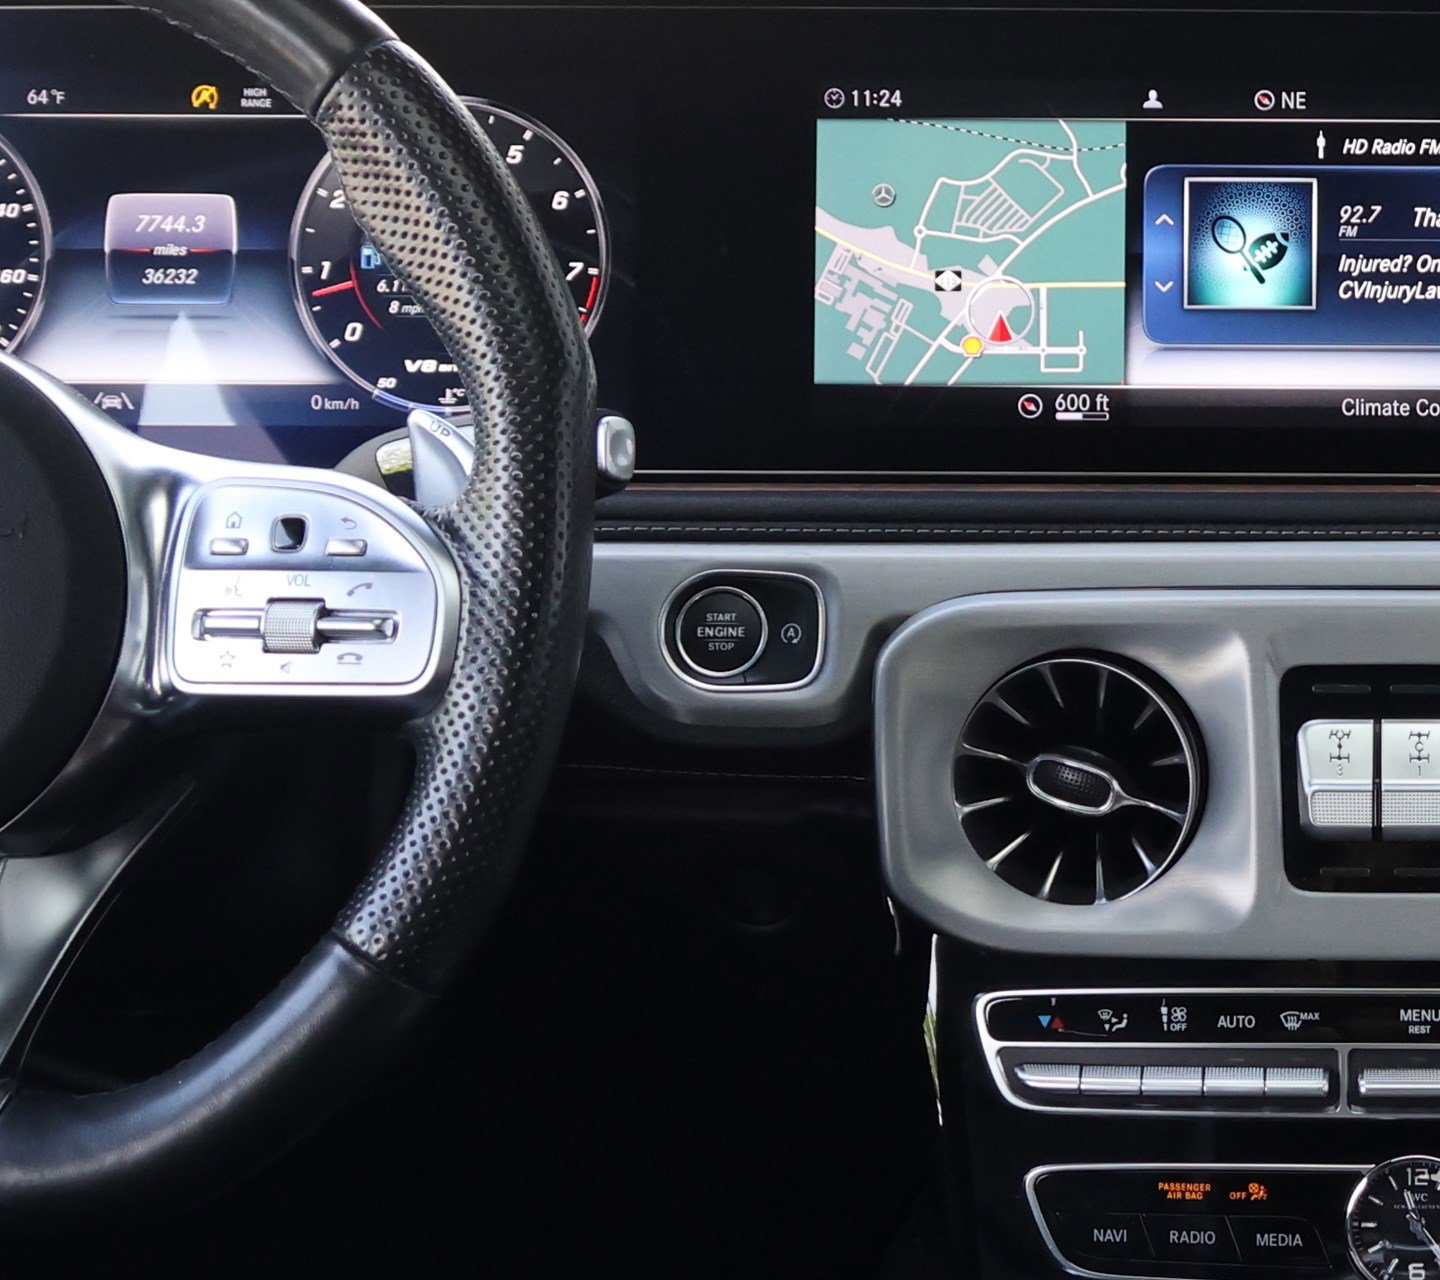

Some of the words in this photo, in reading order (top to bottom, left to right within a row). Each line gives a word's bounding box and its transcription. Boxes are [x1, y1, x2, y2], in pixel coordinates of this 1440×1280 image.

[26, 90, 48, 105] 64
[243, 88, 267, 97] HIGH
[851, 89, 903, 107] 11:24
[240, 98, 272, 108] RANGE
[1281, 92, 1307, 110] NE
[506, 145, 524, 164] 5
[1343, 138, 1369, 155] HD
[1371, 138, 1416, 156] Radio
[329, 190, 346, 209] 2
[552, 191, 570, 210] 6
[1340, 205, 1382, 223] 92.7
[134, 215, 207, 234] 7744.3
[1338, 226, 1358, 237] FM
[153, 244, 188, 256] miles
[320, 261, 331, 280] 1
[565, 262, 584, 281] 7
[1338, 254, 1413, 276] Injured?
[141, 269, 199, 284] 36232
[389, 300, 400, 314] 8
[344, 322, 363, 342] 0
[404, 359, 438, 373] V8
[376, 377, 397, 389] 50
[310, 395, 322, 410] 0
[324, 396, 360, 410] km/h
[1055, 393, 1091, 411] 600
[1095, 393, 1109, 411] ft
[1341, 398, 1410, 417] Climate
[429, 420, 452, 437] UP
[286, 574, 312, 587] VOL
[706, 612, 737, 622] START
[697, 626, 746, 638] ENGINE
[708, 642, 735, 651] STOP
[1336, 765, 1344, 777] 3
[1217, 1015, 1256, 1029] AUTO
[1300, 1012, 1320, 1021] MAX
[1170, 1023, 1188, 1032] OFF
[1408, 1026, 1431, 1035] REST
[1407, 1168, 1429, 1186] 12
[1158, 1182, 1211, 1192] PASSENGER
[1166, 1192, 1182, 1200] AIR
[1185, 1192, 1203, 1200] BAG
[1229, 1192, 1247, 1200] OFF
[1093, 1228, 1128, 1243] NAVI
[1169, 1230, 1216, 1245] RADIO
[1256, 1233, 1303, 1247] MEDIA
[1408, 1263, 1425, 1280] 6
